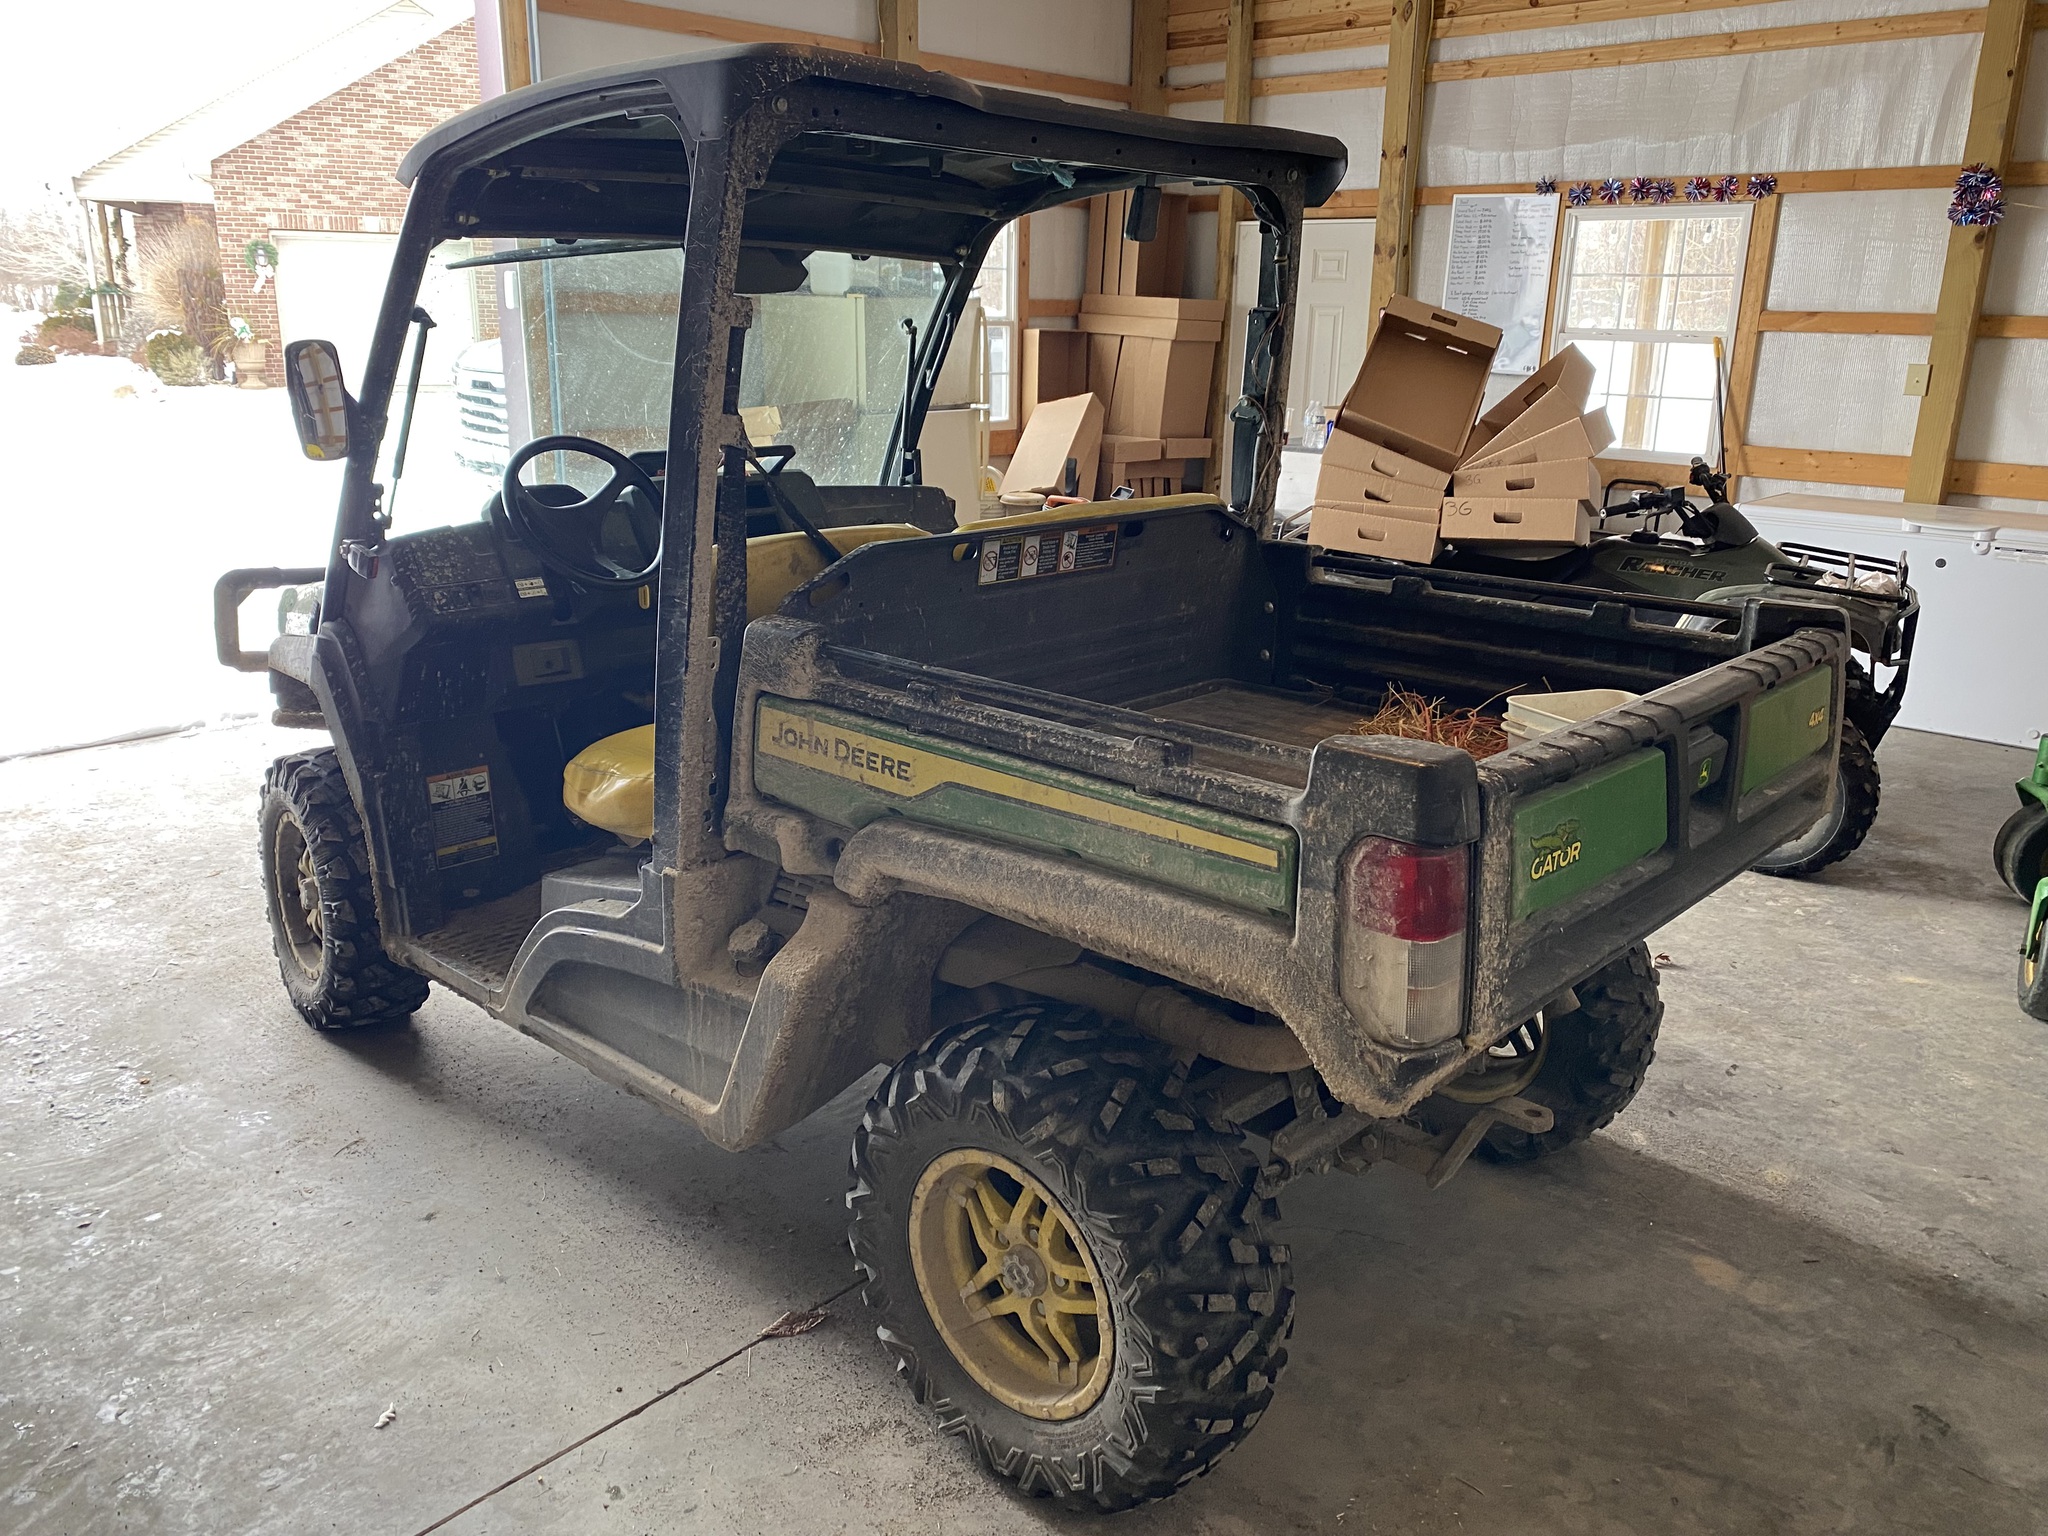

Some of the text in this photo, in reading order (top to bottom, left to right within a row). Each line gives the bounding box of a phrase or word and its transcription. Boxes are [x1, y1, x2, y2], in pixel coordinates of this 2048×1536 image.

[1465, 474, 1481, 486] 3G
[1444, 501, 1473, 517] 3G
[1617, 555, 1727, 583] RANCHER
[1656, 557, 1694, 567] HONDA
[772, 722, 912, 782] JOHN DEERE
[1531, 841, 1582, 880] GATOR
